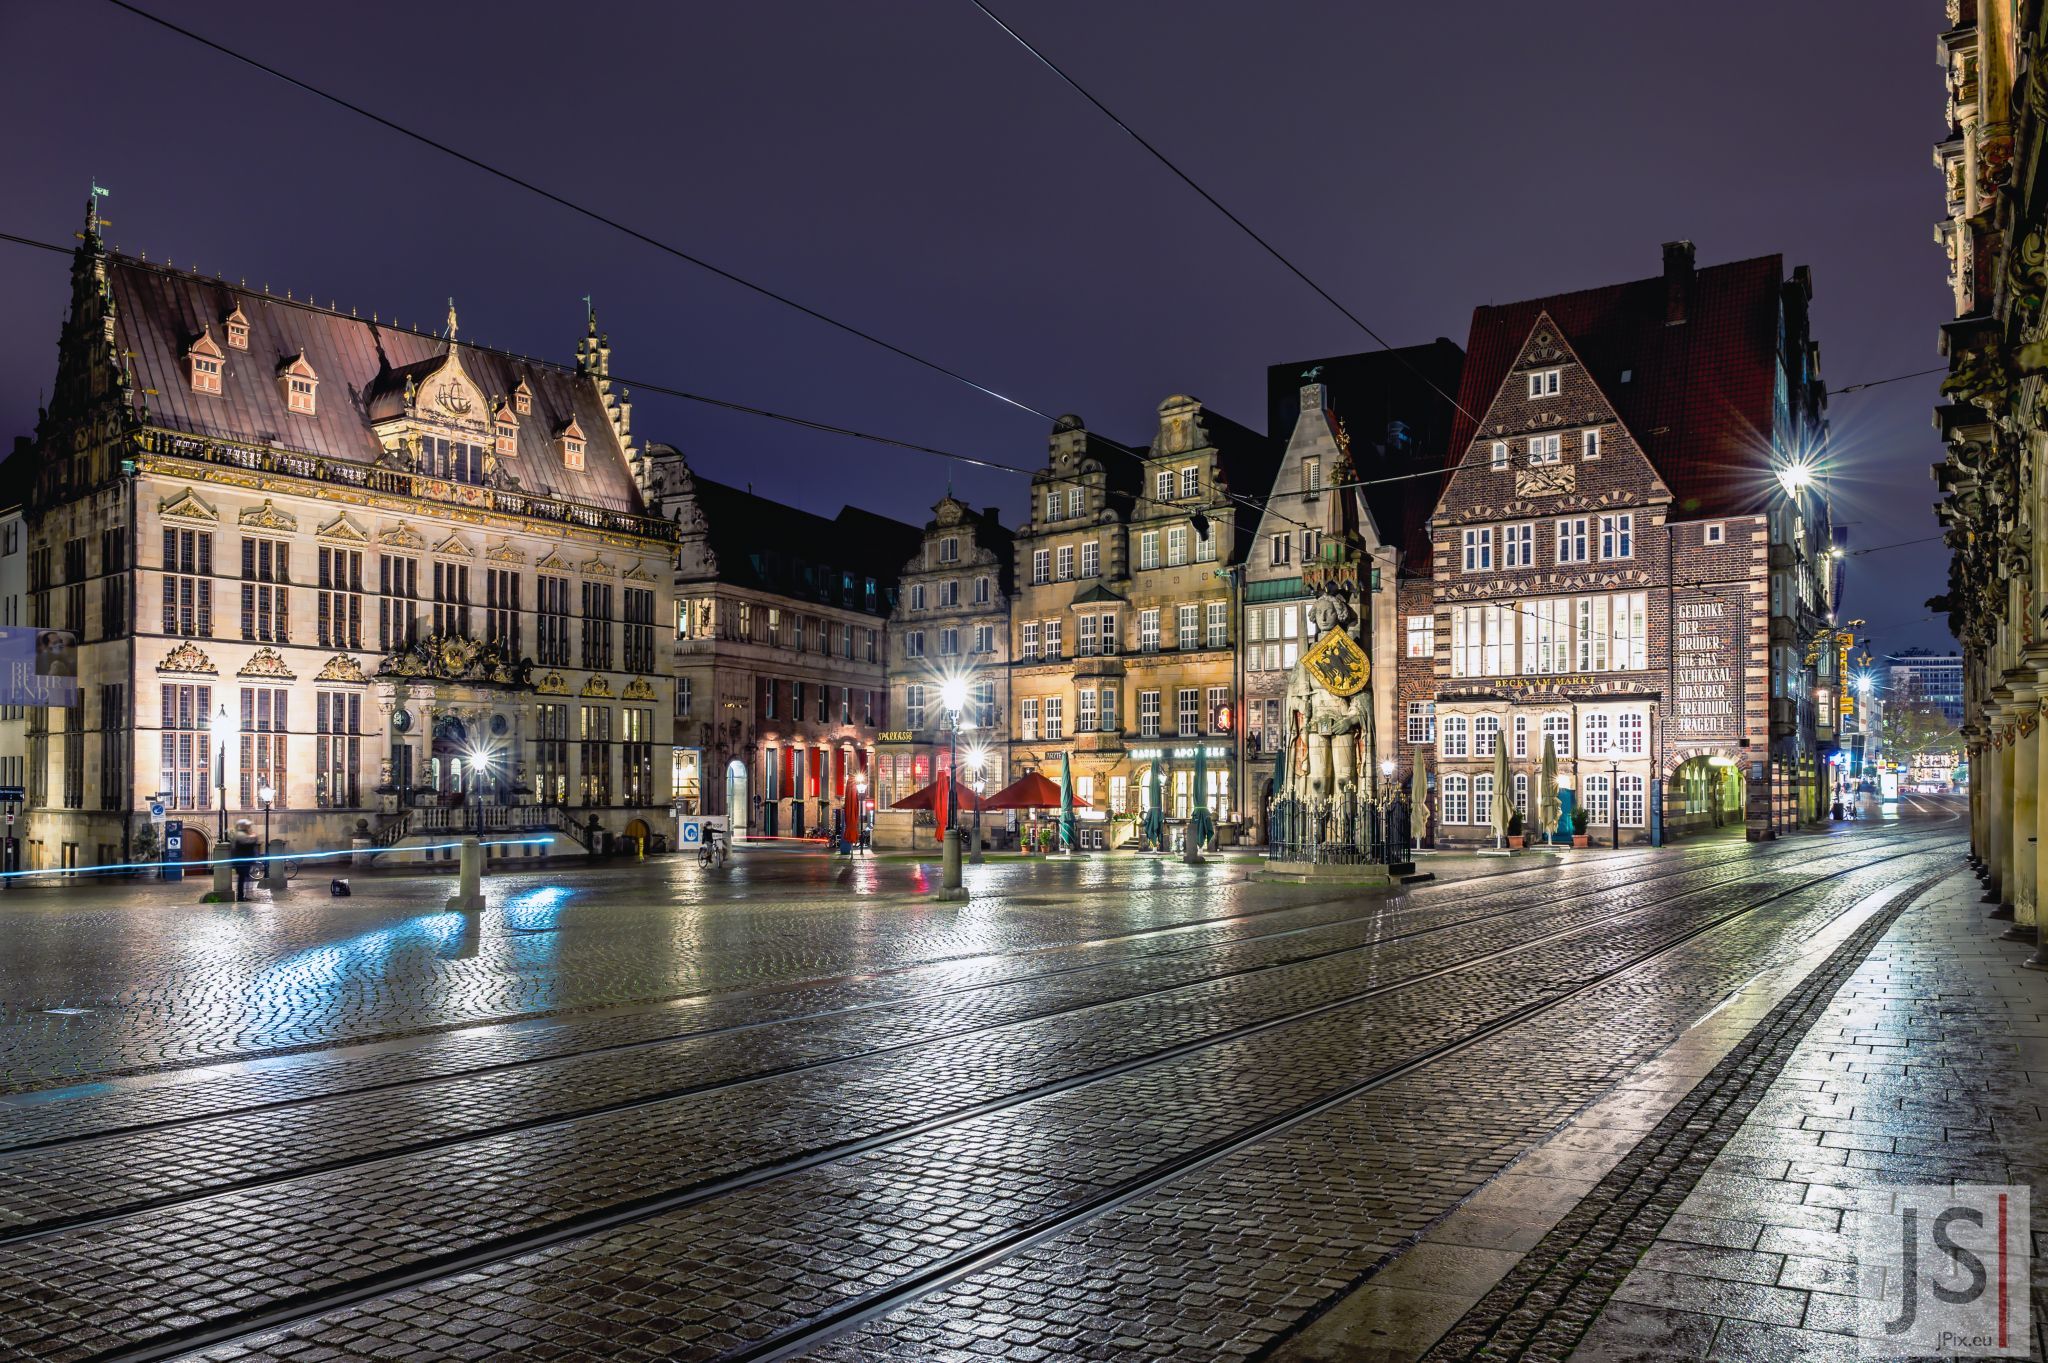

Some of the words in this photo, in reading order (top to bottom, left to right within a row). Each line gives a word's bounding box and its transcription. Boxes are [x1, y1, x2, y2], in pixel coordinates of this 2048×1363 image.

[1679, 603, 1724, 618] GEDENKE
[1679, 621, 1699, 634] DER
[1679, 635, 1724, 650] BRÜDER,
[1679, 653, 1696, 667] DIE
[1699, 652, 1717, 666] DAS
[1534, 678, 1550, 686] AM
[1555, 676, 1596, 686] MARKT
[1679, 668, 1732, 682] SCHICKSAL
[1679, 685, 1725, 699] UNSERER
[1679, 700, 1733, 715] TRENNUNG
